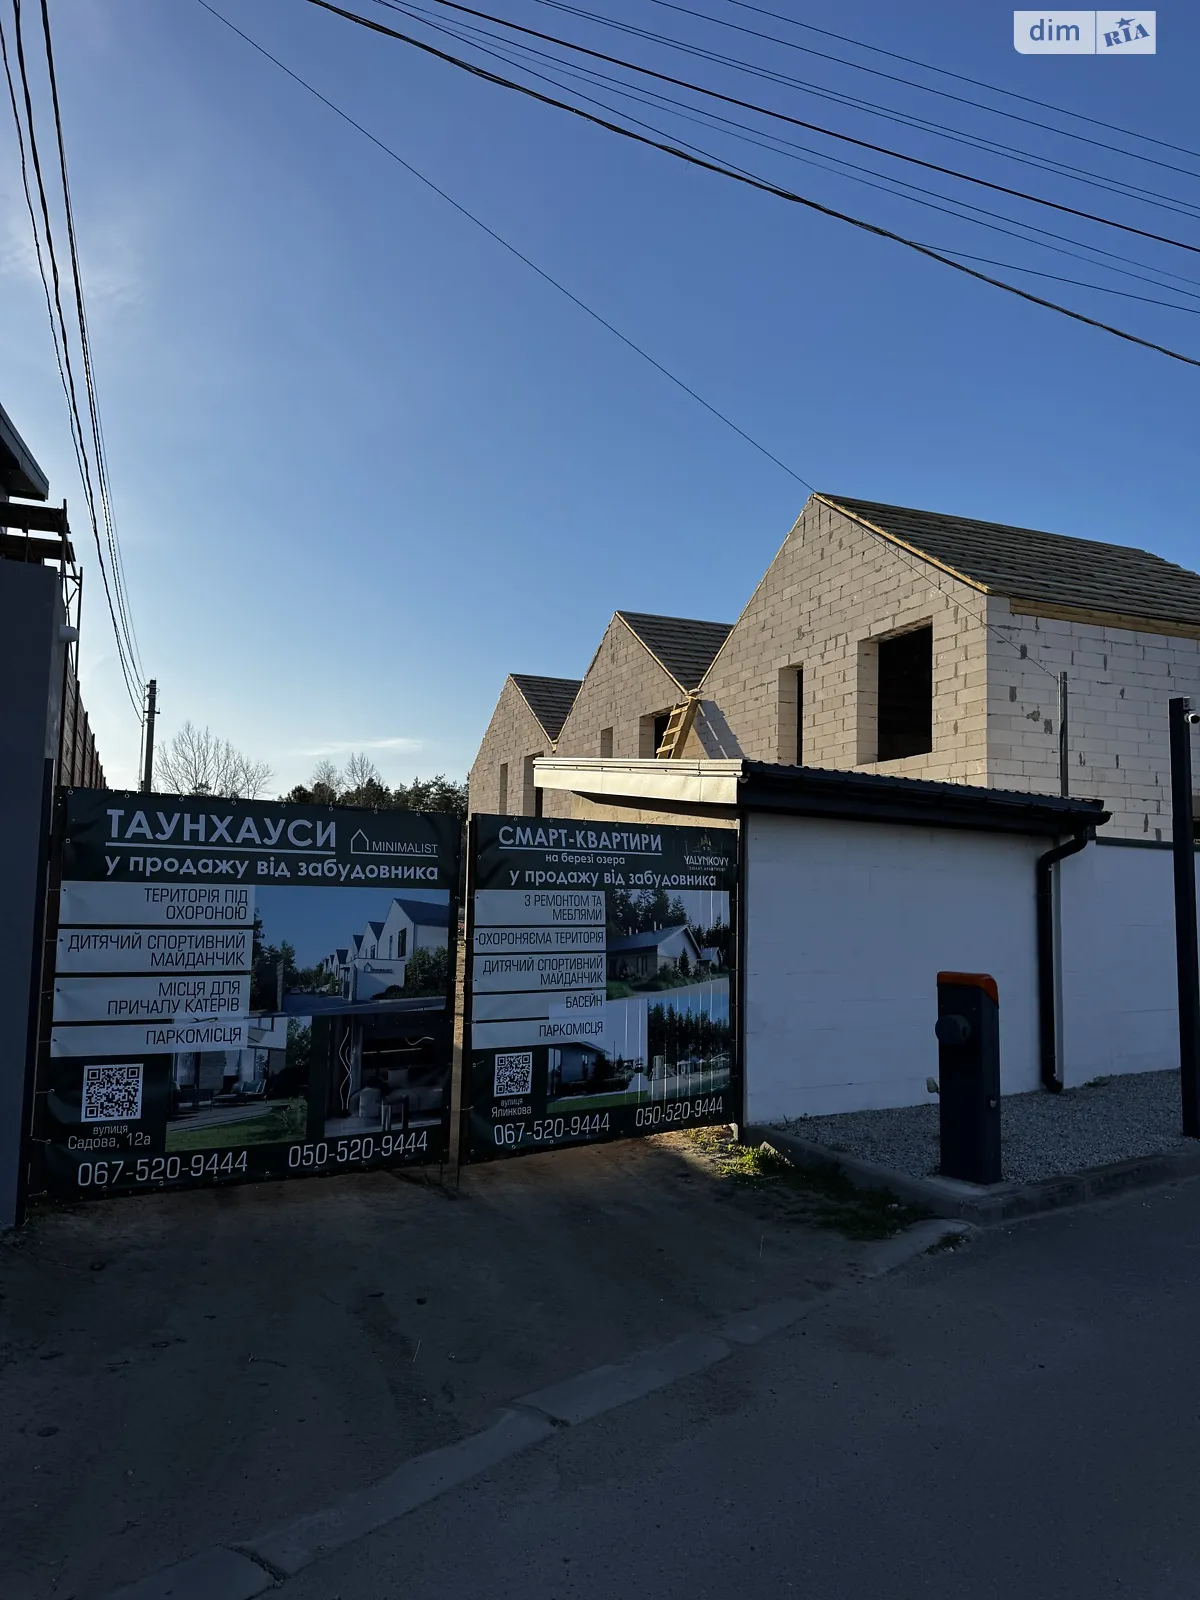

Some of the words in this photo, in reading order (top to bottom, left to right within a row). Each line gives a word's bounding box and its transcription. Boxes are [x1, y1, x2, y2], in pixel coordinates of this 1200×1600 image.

[106, 808, 336, 848] ТАУНХАУСИ
[372, 841, 439, 854] MINIMALIST
[498, 825, 662, 852] СМАРТ-КВАРТИРИ
[104, 855, 121, 876] у
[129, 856, 249, 878] продажу
[256, 855, 291, 878] від
[298, 858, 439, 881] забудовника
[545, 853, 560, 863] на
[561, 852, 594, 865] березі
[596, 855, 625, 867] озера
[683, 855, 729, 867] YALYNKOVY
[509, 870, 520, 885] у
[525, 870, 598, 886] продажу
[603, 869, 626, 885] від
[628, 871, 717, 887] забудовника
[144, 888, 220, 903] ТЕРИТОРІЯ
[224, 889, 248, 906] ПІД
[534, 895, 590, 907] РЕМОНТОМ
[591, 895, 603, 906] ТА
[166, 905, 247, 920] ОХОРОНОЮ
[552, 908, 602, 921] МЕБЛЯМИ
[68, 932, 142, 952] ДИТЯЧИЙ
[147, 932, 245, 950] СПОРТИВНИЙ
[478, 931, 552, 945] ОХОРОНЯЄМА
[555, 931, 604, 944] ТЕРИТОРІЯ
[150, 950, 245, 969] МАЙДАНЧИК
[483, 957, 534, 975] ДИТЯЧИЙ
[537, 956, 603, 971] СПОРТИВНИЙ
[540, 971, 603, 987] МАЙДАНЧИК
[158, 981, 206, 999] МІСЦЯ
[209, 981, 241, 997] ДЛЯ
[107, 999, 180, 1015] ПРИЧАЛУ
[184, 997, 240, 1013] КАТЕРІВ
[565, 992, 603, 1009] БАСЕЙН
[145, 1027, 242, 1044] ПАРКОМІСЦЯ
[539, 1021, 603, 1038] ПАРКОМІСЦЯ
[491, 1105, 532, 1118] Ялинкова
[635, 1095, 723, 1127] 050-520-9444
[92, 1125, 129, 1136] вулиця
[494, 1112, 611, 1146] 067-520-9444
[67, 1135, 120, 1151] Садова,
[126, 1133, 151, 1147] 12а
[288, 1131, 429, 1168] 050-520-9444
[77, 1151, 248, 1186] 067-520-9444
